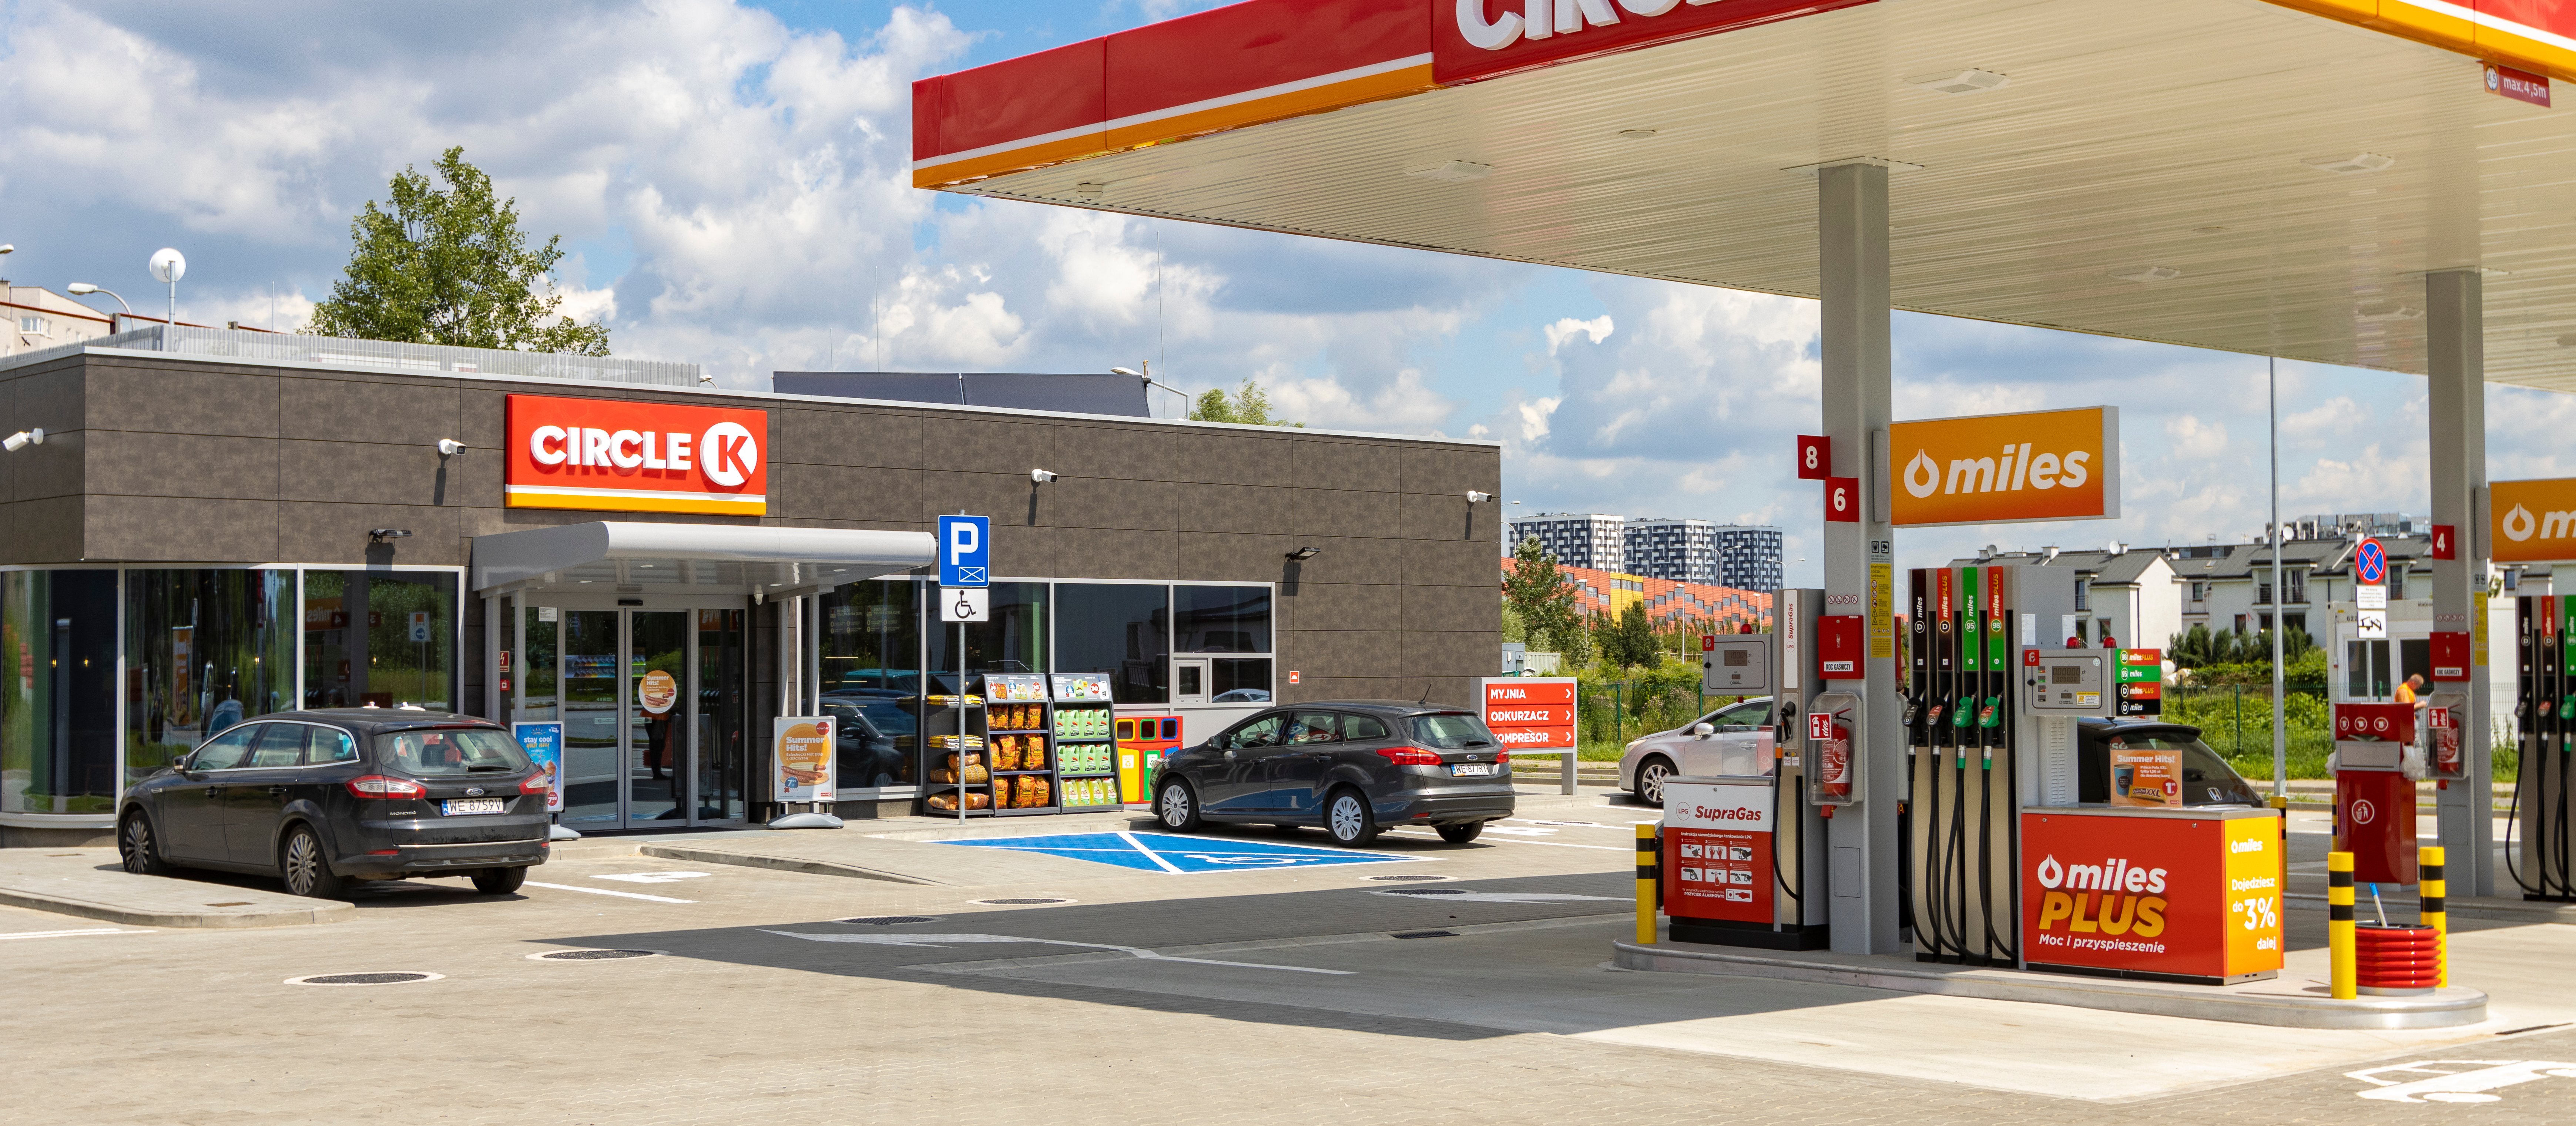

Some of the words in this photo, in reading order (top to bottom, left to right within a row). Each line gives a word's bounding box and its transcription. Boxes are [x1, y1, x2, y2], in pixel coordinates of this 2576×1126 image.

[530, 425, 691, 470] CIRCLE
[1806, 446, 1818, 469] 8
[1944, 443, 2090, 495] miles
[1834, 487, 1846, 511] 6
[951, 522, 979, 565] P
[2436, 532, 2445, 552] 4
[1705, 638, 1711, 648] 8
[2028, 652, 2035, 662] 6
[1490, 689, 1526, 699] MYJNIA
[1491, 710, 1549, 721] ODKURZACZ
[1494, 732, 1549, 743] OMPRESOR
[2117, 754, 2153, 763] Summer
[2155, 755, 2175, 763] Hits!
[1455, 764, 1466, 773] WE
[1467, 764, 1486, 773] 877RY
[2146, 789, 2161, 797] XXL
[449, 800, 465, 811] WE
[469, 799, 500, 811] 8759V
[1695, 805, 1762, 821] SupraGas
[2238, 838, 2263, 853] miles
[2066, 858, 2167, 893] miles
[2232, 876, 2275, 892] Dojedziesz
[2039, 891, 2168, 937] PLUS
[2233, 900, 2243, 912] do
[2244, 897, 2276, 930] 3%
[2039, 934, 2063, 946] Moc
[2066, 935, 2071, 946] i
[2073, 938, 2165, 953] przyspieszenie
[2257, 936, 2277, 950] dalej
